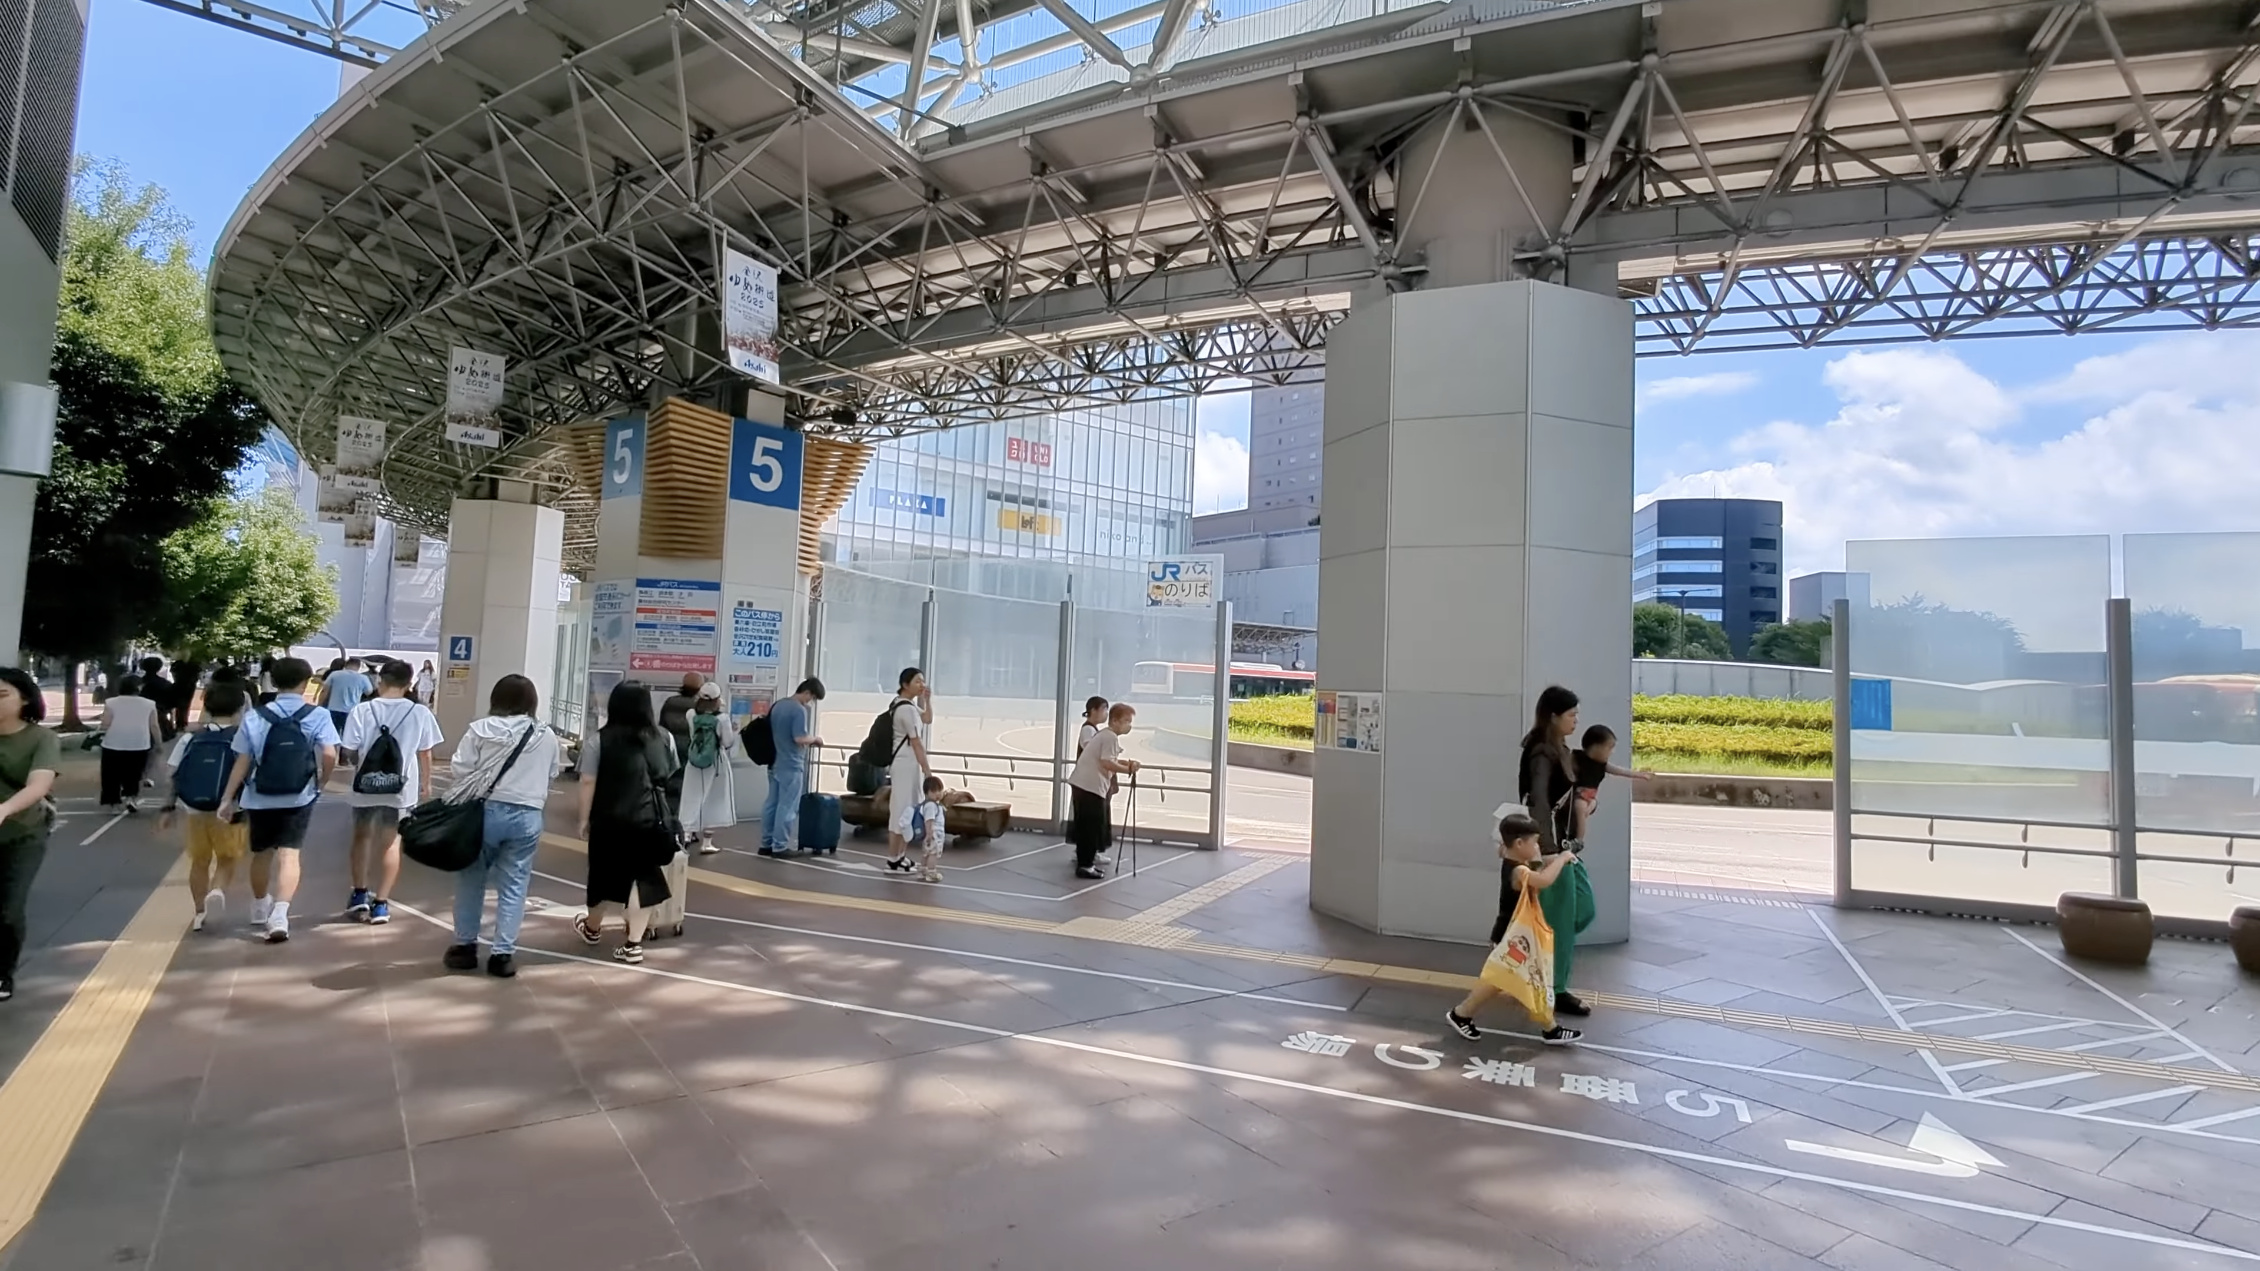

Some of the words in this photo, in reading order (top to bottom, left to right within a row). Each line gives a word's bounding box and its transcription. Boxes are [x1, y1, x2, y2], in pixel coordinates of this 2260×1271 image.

[740, 292, 765, 309] 2025
[744, 358, 767, 374] Asahi
[465, 377, 491, 390] 2025
[460, 430, 486, 441] Asahi
[613, 428, 634, 484] 5
[749, 436, 783, 492] 5
[1151, 563, 1180, 581] JR
[1185, 563, 1208, 575] バス
[1164, 583, 1209, 598] のりば
[453, 639, 468, 659] 4
